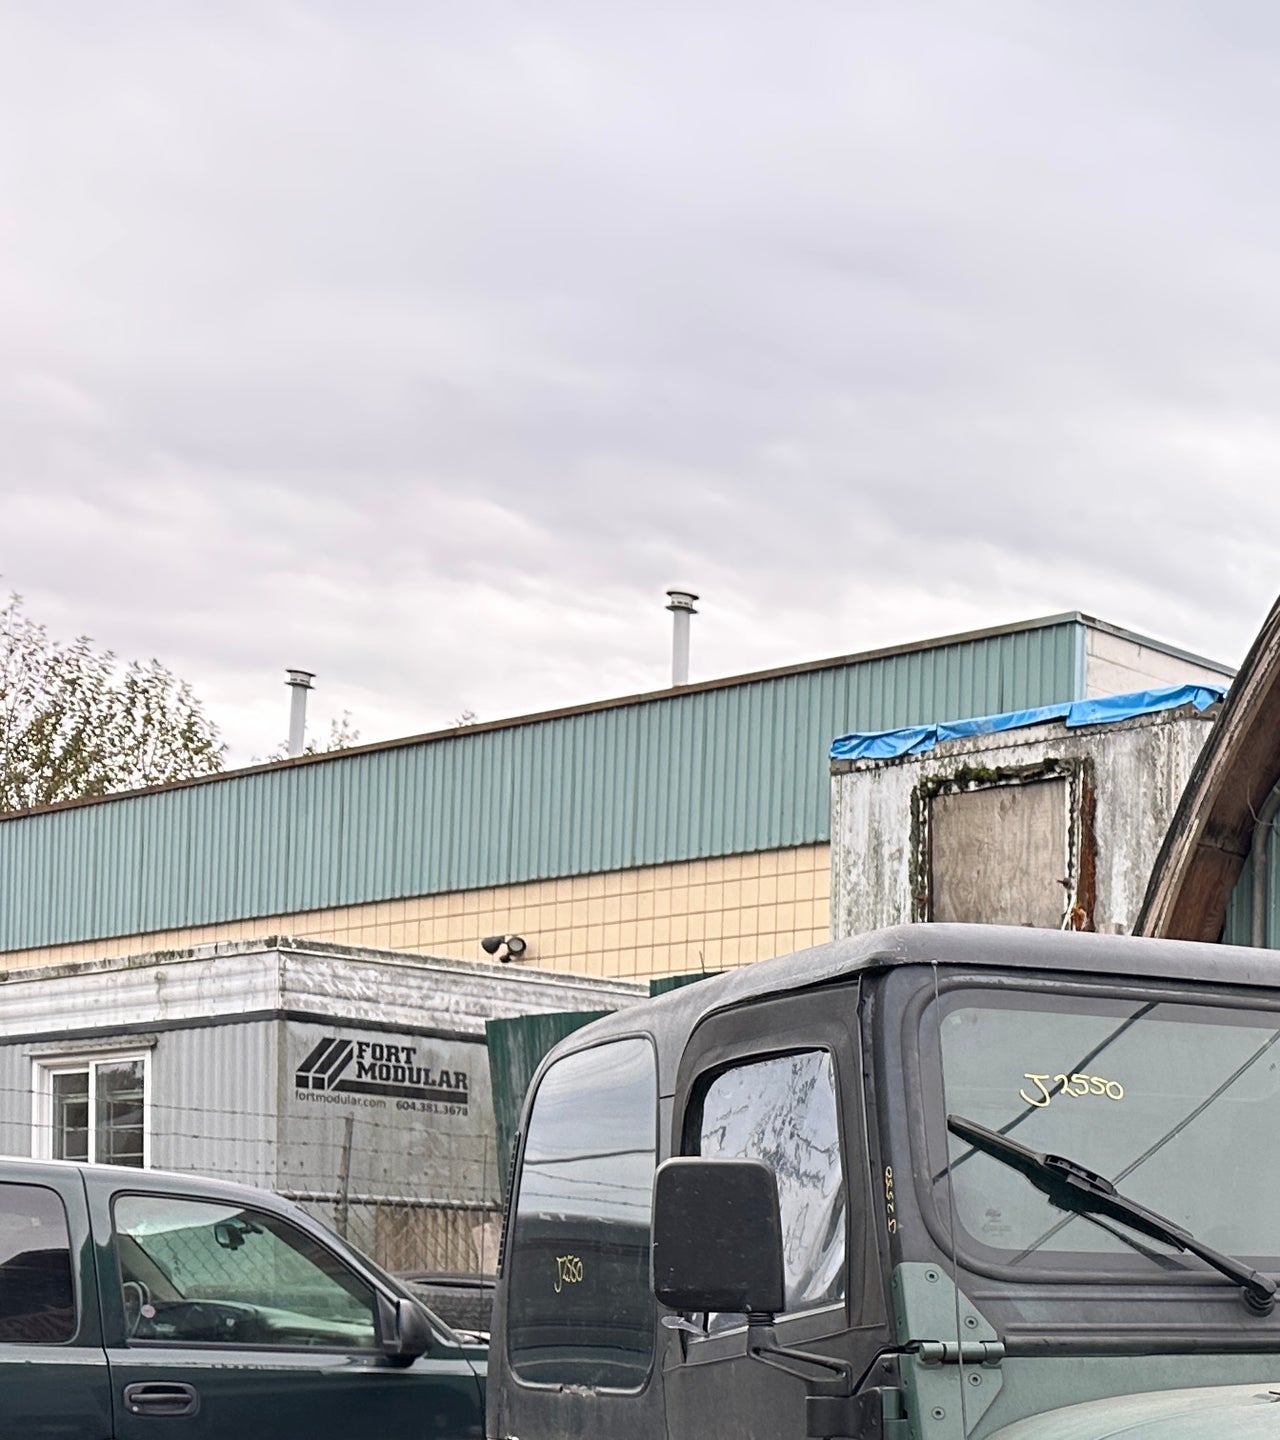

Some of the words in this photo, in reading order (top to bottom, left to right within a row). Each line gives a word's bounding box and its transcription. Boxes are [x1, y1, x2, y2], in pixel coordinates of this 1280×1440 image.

[356, 1041, 416, 1064] FORT
[356, 1062, 468, 1090] MODULAR
[295, 1090, 386, 1109] fortmodular.com
[1020, 1073, 1124, 1107] J2550
